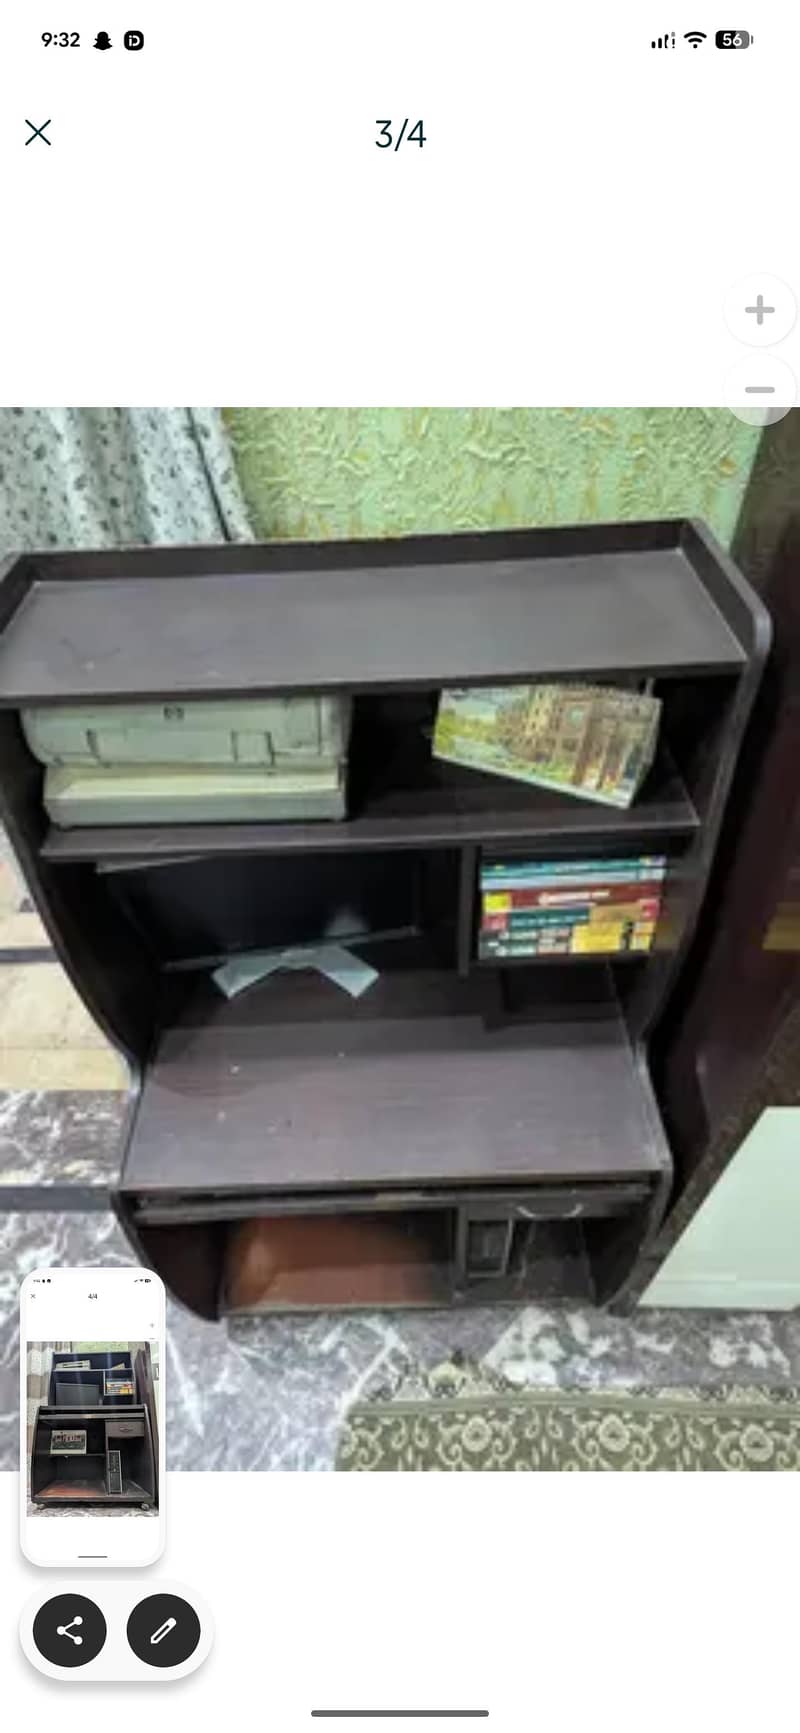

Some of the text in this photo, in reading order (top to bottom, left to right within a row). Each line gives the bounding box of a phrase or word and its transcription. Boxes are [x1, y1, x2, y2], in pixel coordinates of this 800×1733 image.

[41, 31, 81, 48] 9:32
[722, 33, 743, 47] 56
[375, 118, 427, 152] 3/4
